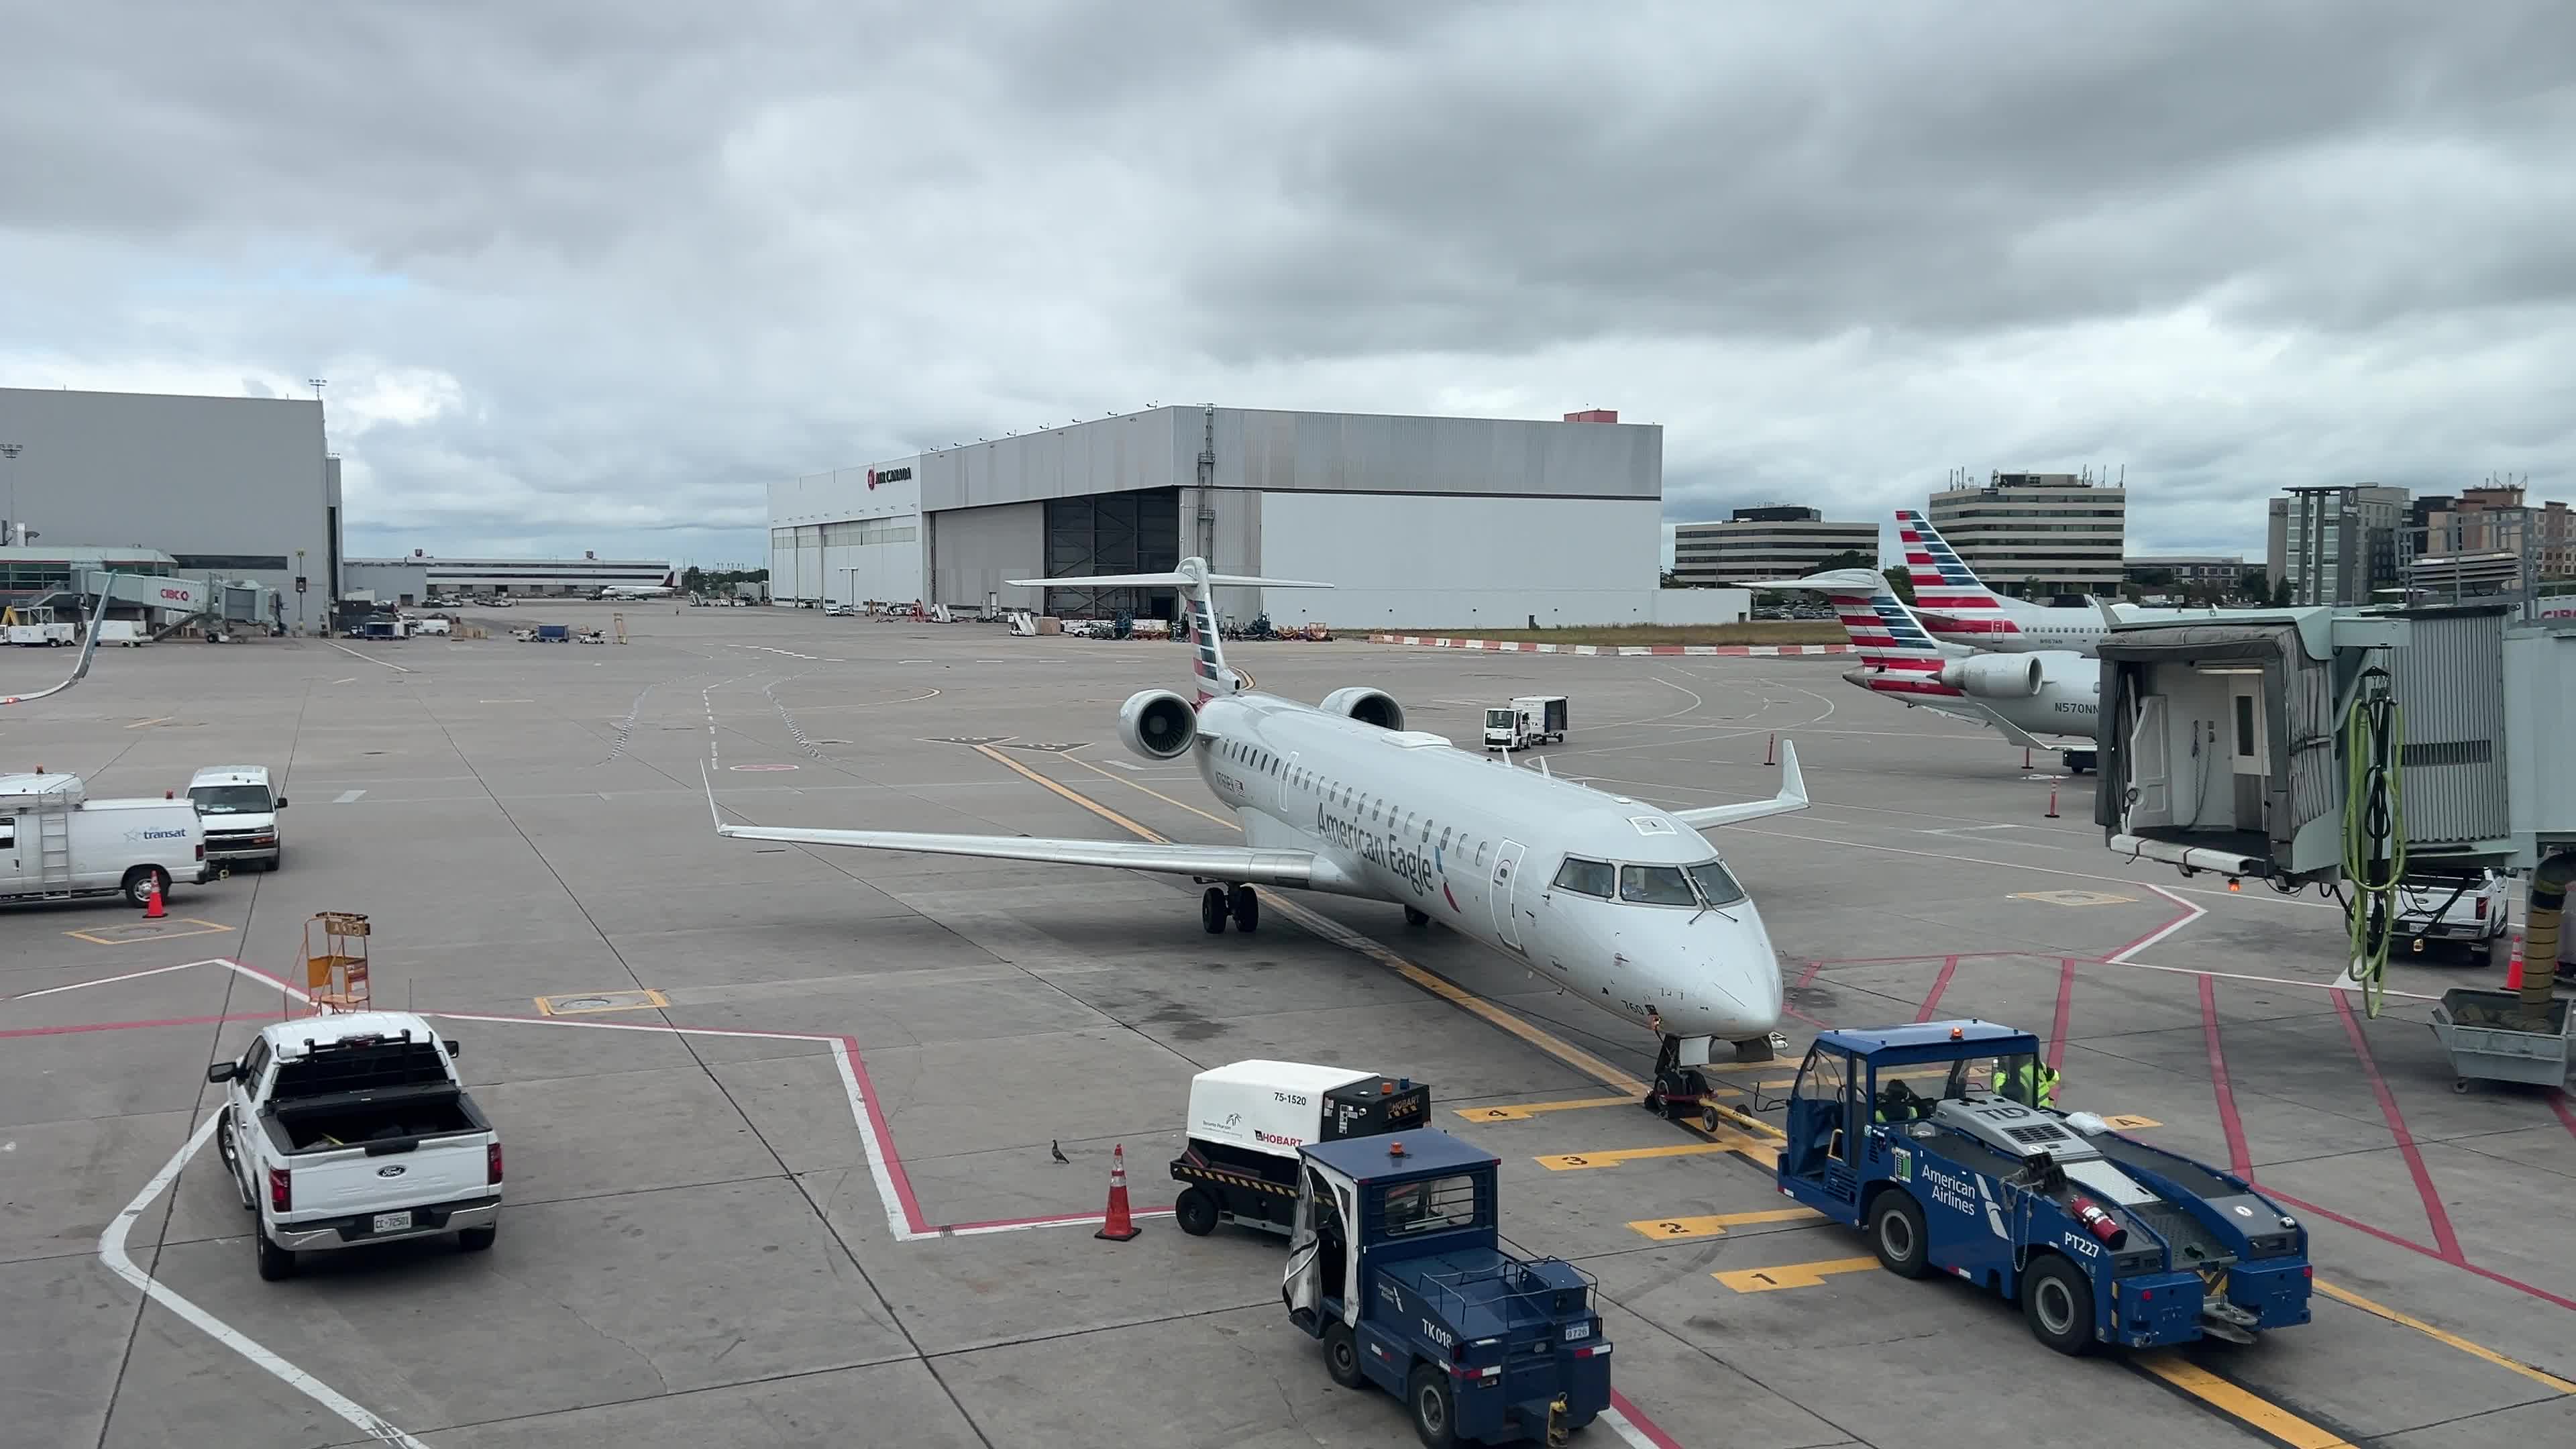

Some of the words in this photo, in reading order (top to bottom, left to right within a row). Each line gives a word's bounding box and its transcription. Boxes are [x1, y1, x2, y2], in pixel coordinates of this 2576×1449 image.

[160, 588, 179, 600] CIBC
[144, 828, 186, 839] transat
[1318, 802, 1387, 869] American
[1389, 833, 1434, 896] Eagle
[1621, 1000, 1644, 1016] 760
[1275, 1092, 1307, 1106] 75-1520
[1393, 1094, 1420, 1110] HOBART
[1976, 1108, 2031, 1120] TLD
[2115, 1118, 2143, 1126] A
[1263, 1133, 1303, 1147] HOBART
[1562, 1157, 1588, 1165] 3
[1921, 1164, 1976, 1199] American
[1931, 1185, 1975, 1216] Airlines
[1659, 1222, 1690, 1234] 2
[2065, 1232, 2100, 1258] PT227
[1750, 1273, 1778, 1285] 1
